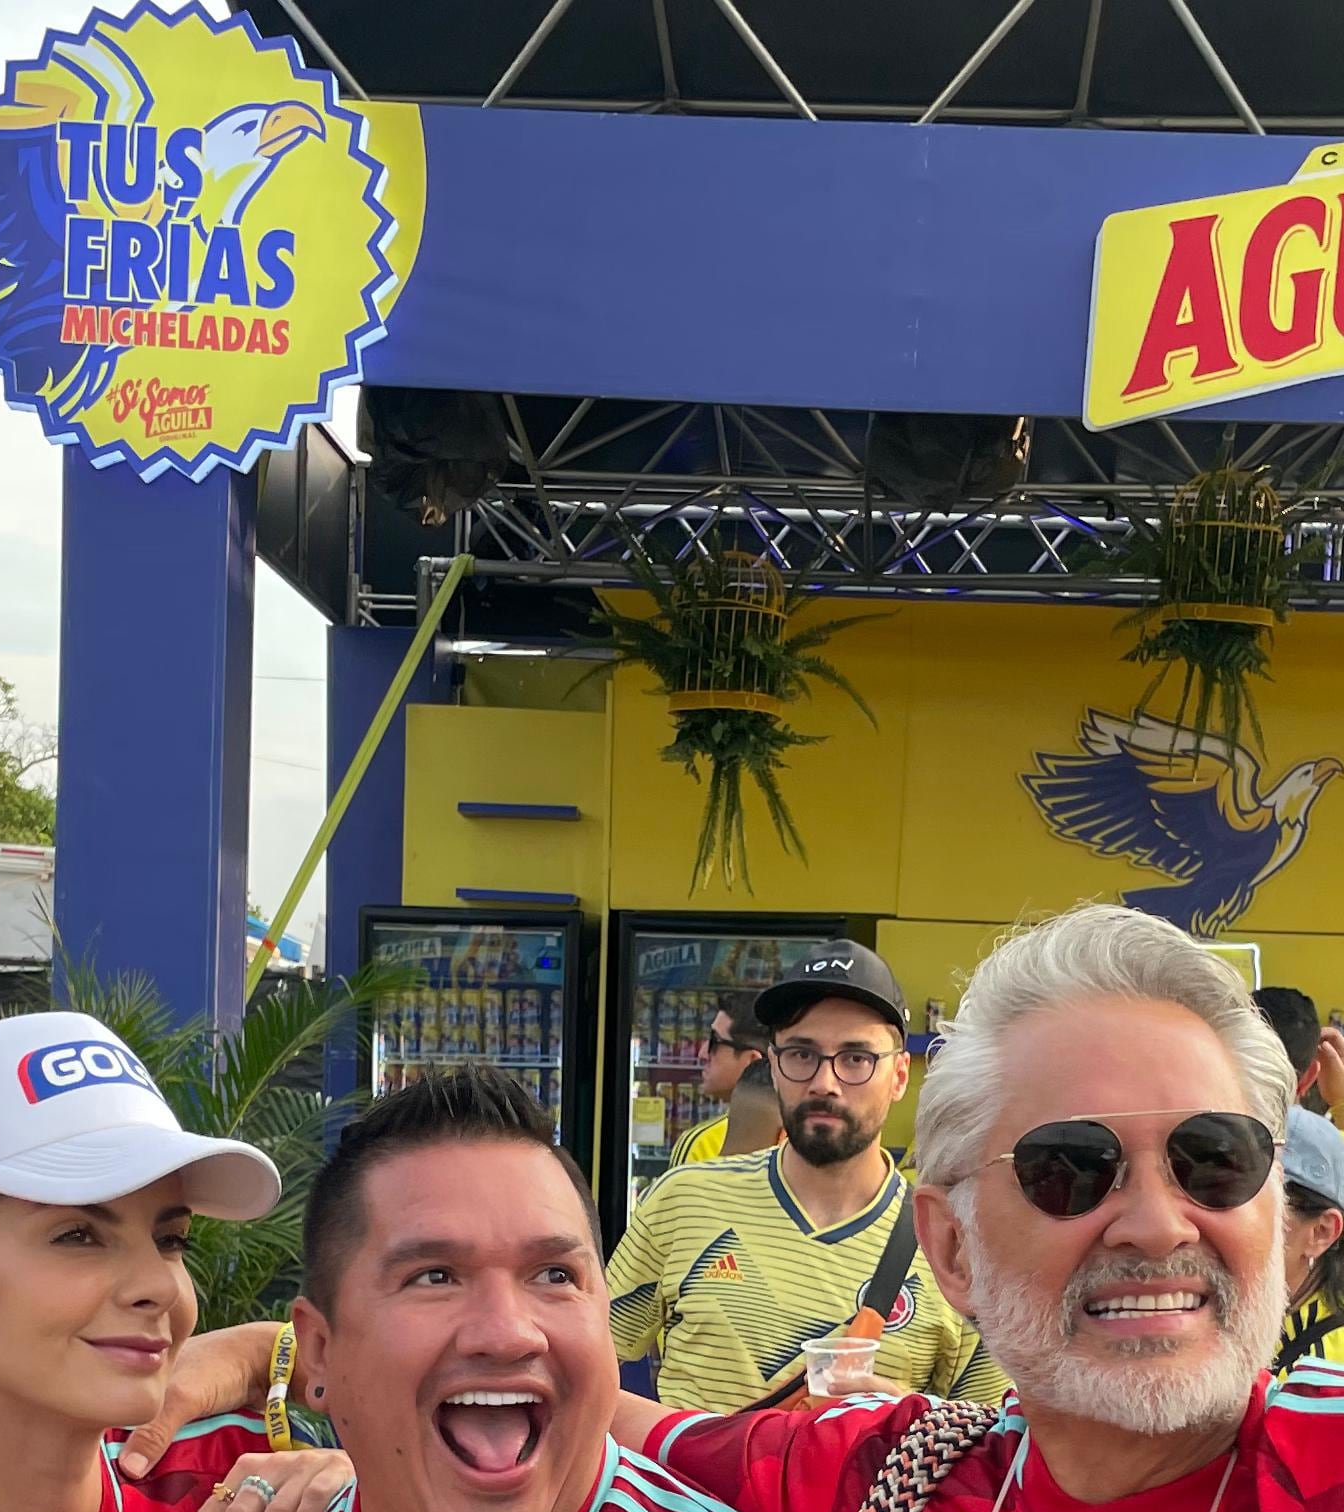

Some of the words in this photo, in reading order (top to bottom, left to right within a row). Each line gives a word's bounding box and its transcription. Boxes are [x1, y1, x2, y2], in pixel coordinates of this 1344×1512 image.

[58, 121, 204, 207] TUS
[66, 200, 296, 310] FRÍAS
[61, 306, 291, 356] MICHELADAS
[139, 377, 211, 423] Somos
[641, 943, 698, 974] AGUILA
[805, 959, 854, 973] ION
[704, 1268, 744, 1281] adidas
